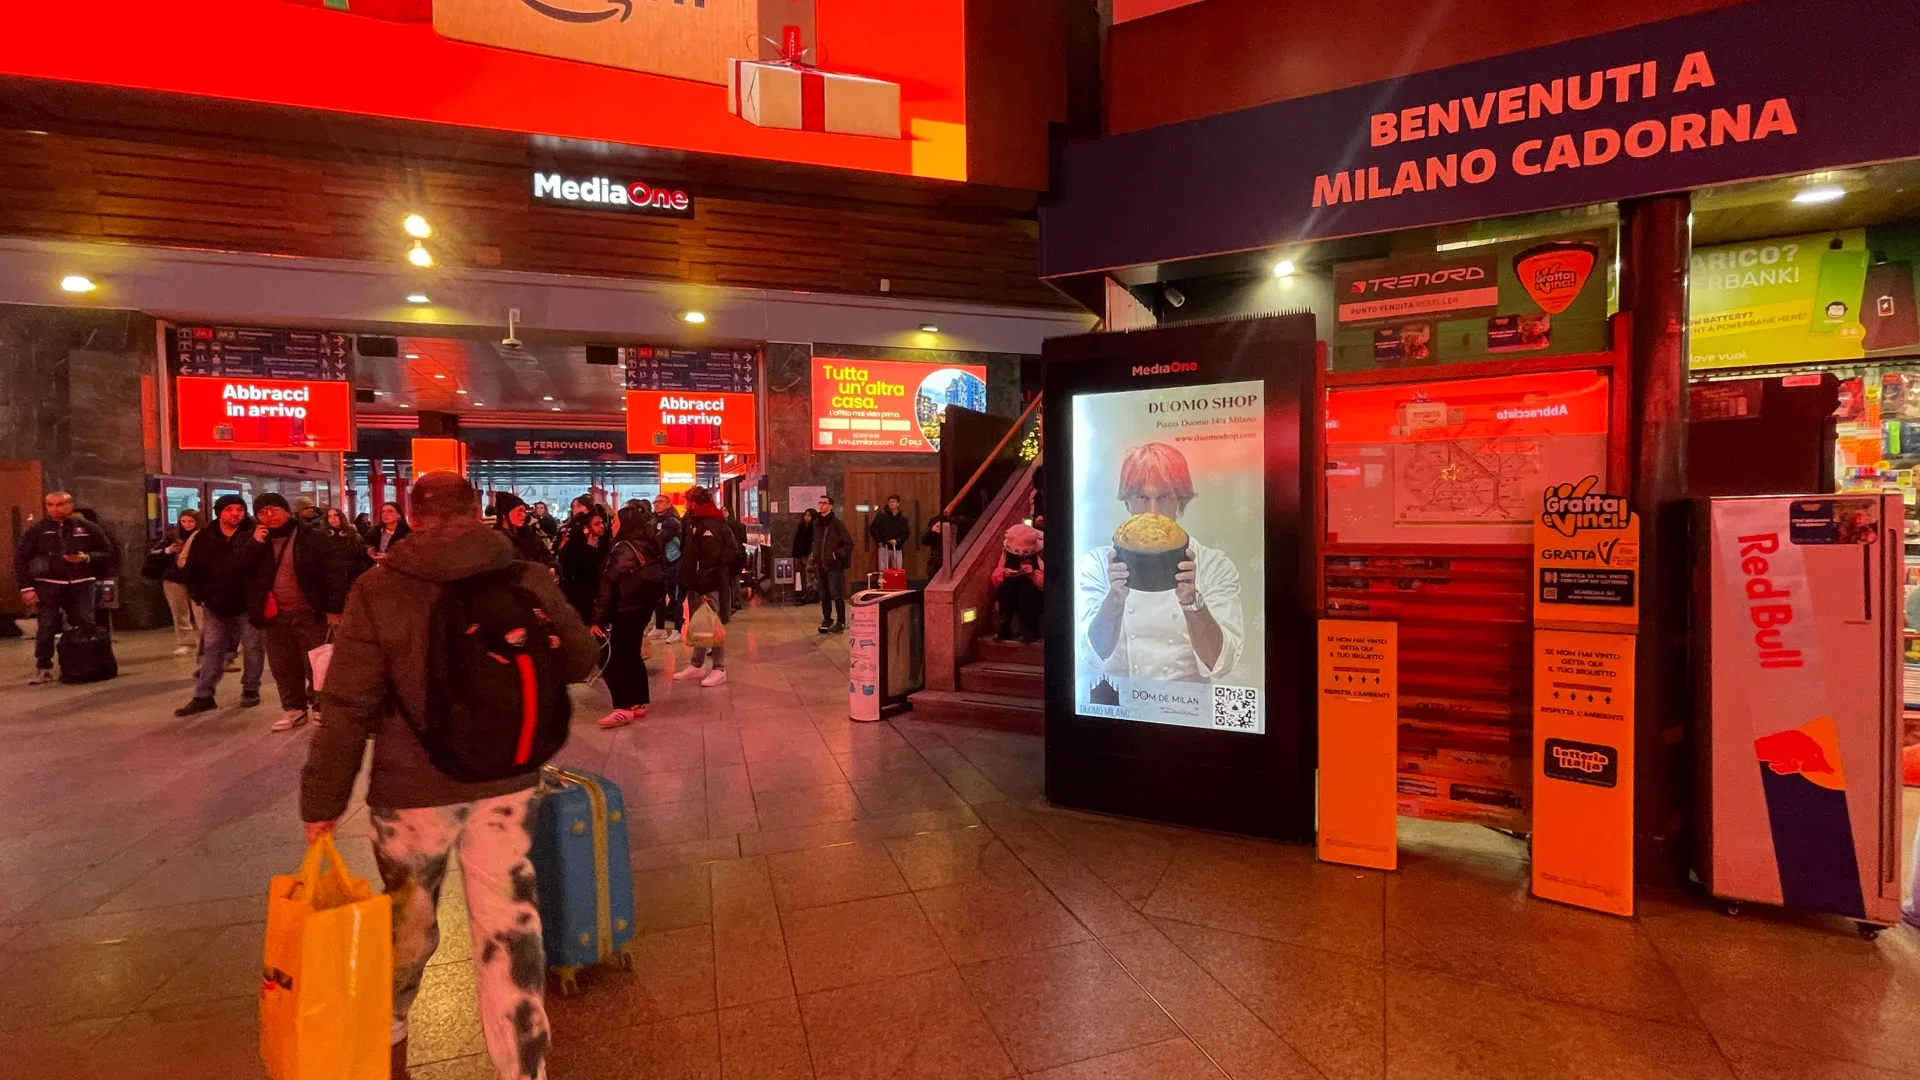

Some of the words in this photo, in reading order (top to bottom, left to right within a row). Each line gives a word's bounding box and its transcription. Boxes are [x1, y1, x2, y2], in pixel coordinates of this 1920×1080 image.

[1370, 60, 1657, 148] BENVENUTI
[1671, 50, 1716, 93] A
[1311, 147, 1498, 209] MILANO
[1511, 97, 1798, 177] CADORNA
[533, 172, 690, 211] MediaOne
[1368, 267, 1485, 292] TRENORD
[1350, 306, 1378, 315] PUNTO
[1380, 302, 1414, 312] VENDITA
[1416, 297, 1459, 307] RESELLER
[1703, 311, 1754, 324] BATTERY?
[1716, 318, 1775, 331] POWERBANK
[1777, 312, 1808, 322] HERE!
[822, 365, 869, 382] Tutta
[1132, 361, 1198, 376] MediaOne
[223, 384, 309, 401] Abbracci
[838, 380, 905, 397] un'altra
[226, 402, 245, 416] in
[248, 403, 307, 419] arrivo
[659, 396, 725, 411] Abbracci
[831, 395, 879, 409] casa.
[1148, 398, 1209, 414] DUOMO
[1212, 394, 1258, 409] SHOP
[662, 412, 676, 424] in
[678, 412, 722, 426] arrivo
[1156, 421, 1179, 429] Piazza
[1181, 419, 1209, 427] Duomo
[1228, 415, 1257, 424] Milano
[533, 441, 613, 450] FERROVIENORD
[1174, 431, 1257, 443] www.duomoshop.com
[1546, 495, 1619, 513] Gratta
[1541, 549, 1596, 561] GRATTA
[1737, 533, 1791, 600] Red
[1750, 604, 1804, 668] Bull
[1556, 649, 1576, 657] NON
[1594, 652, 1621, 660] VINTO
[1561, 658, 1586, 666] GETTA
[1587, 660, 1604, 668] QUI
[1556, 666, 1574, 674] TUO
[1576, 668, 1617, 678] BIGLIETTO
[1158, 694, 1170, 702] DE
[1171, 695, 1199, 705] MILAN
[1080, 704, 1104, 716] DUOMO
[1104, 707, 1130, 719] MILANO
[1540, 706, 1575, 716] RISPETTA
[1553, 746, 1609, 766] Lotteria
[1559, 756, 1603, 773] Italia
